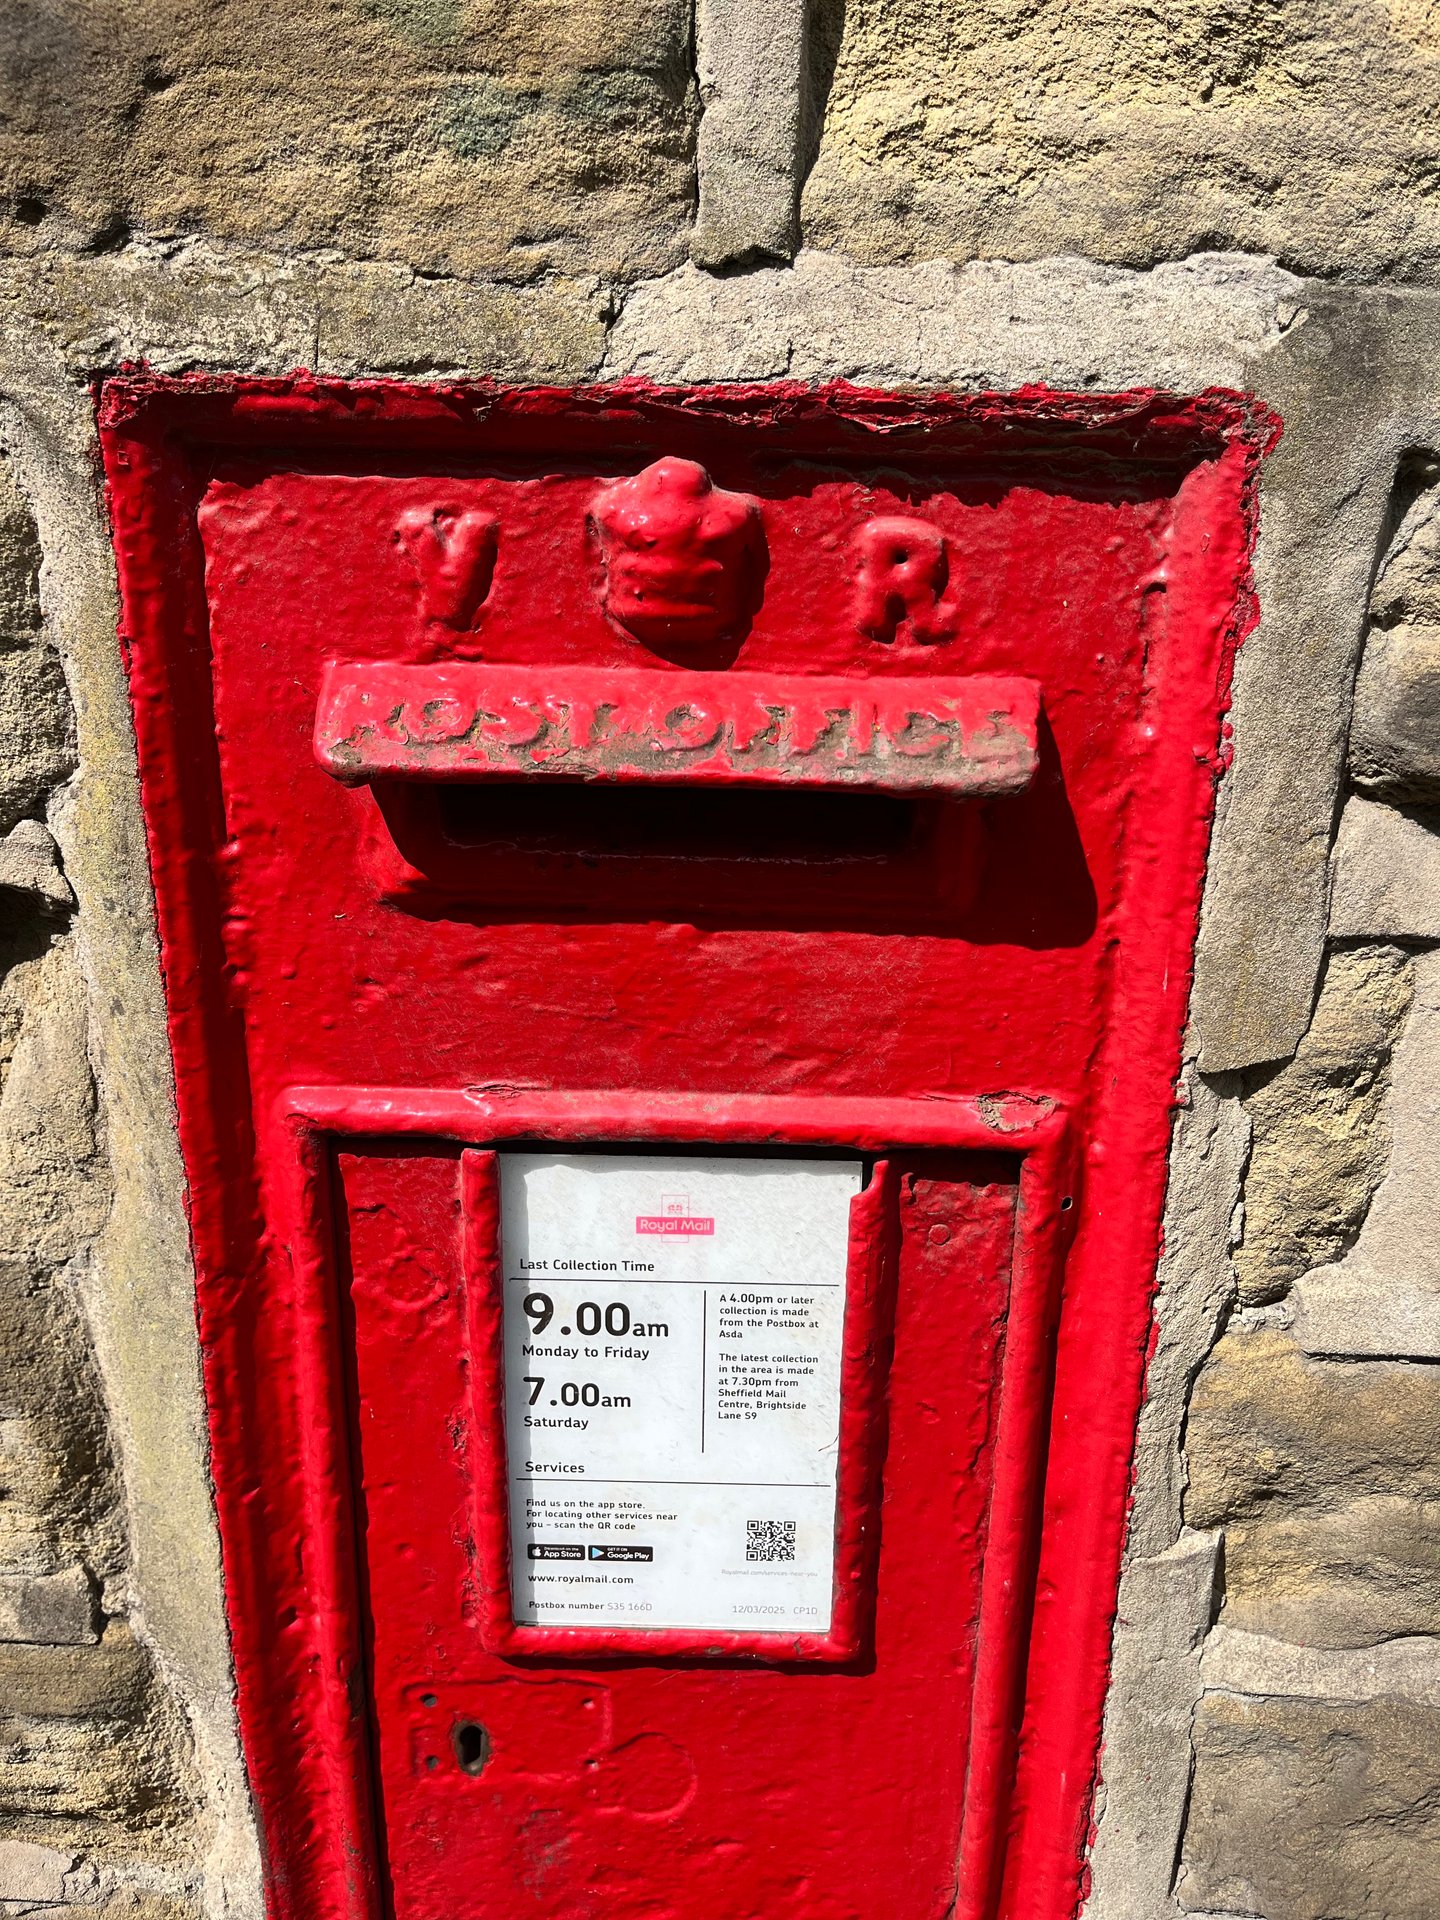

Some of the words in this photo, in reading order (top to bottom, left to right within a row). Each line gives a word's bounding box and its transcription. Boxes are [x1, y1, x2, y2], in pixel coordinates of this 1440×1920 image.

[853, 514, 957, 646] R
[639, 1219, 678, 1234] Royal
[680, 1219, 711, 1232] Mail
[519, 1258, 549, 1270] Last
[552, 1258, 618, 1271] Collection
[620, 1260, 655, 1272] Time
[719, 1293, 727, 1303] A
[729, 1292, 774, 1306] 4.00pm
[790, 1295, 815, 1305] later
[522, 1292, 669, 1340] 9.00am
[719, 1306, 767, 1316] collection
[770, 1307, 779, 1316] is
[782, 1307, 810, 1317] made
[719, 1317, 744, 1327] from
[746, 1318, 764, 1328] the
[766, 1318, 806, 1328] Postbox
[808, 1320, 820, 1329] at
[718, 1330, 743, 1339] Asda
[522, 1343, 580, 1360] Monday
[583, 1346, 599, 1358] to
[604, 1346, 650, 1362] Friday
[718, 1352, 738, 1362] The
[740, 1353, 769, 1363] latest
[771, 1354, 819, 1364] collection
[718, 1364, 728, 1373] in
[730, 1364, 748, 1374] the
[750, 1366, 773, 1374] area
[775, 1365, 784, 1375] is
[787, 1366, 815, 1375] made
[718, 1377, 729, 1386] at
[731, 1376, 772, 1388] 7.30pm
[774, 1377, 799, 1387] from
[522, 1376, 631, 1408] 7.00am
[718, 1388, 763, 1398] Sheffield
[765, 1389, 787, 1398] Mail
[718, 1400, 753, 1412] Centre,
[756, 1400, 807, 1413] Brightside
[717, 1410, 742, 1420] Lane
[744, 1411, 758, 1420] S9
[523, 1415, 589, 1431] Saturday
[524, 1460, 585, 1474] Services
[525, 1498, 547, 1508] Find
[550, 1500, 561, 1508] us
[579, 1500, 595, 1509] the
[597, 1502, 616, 1510] app
[618, 1501, 646, 1510] store.
[526, 1510, 542, 1519] For
[544, 1510, 582, 1521] locating
[585, 1511, 612, 1520] other
[614, 1512, 653, 1521] services
[525, 1521, 544, 1530] you
[578, 1521, 595, 1530] the
[597, 1521, 611, 1530] QR
[614, 1522, 636, 1531] code
[544, 1550, 560, 1559] App
[561, 1550, 582, 1559] Store
[607, 1551, 634, 1560] Google
[634, 1552, 650, 1561] Play
[527, 1574, 634, 1585] www.royalmail.com
[528, 1601, 566, 1610] Postbox
[568, 1601, 605, 1611] number
[607, 1602, 625, 1611] S35
[732, 1605, 786, 1615] 12/03/2025
[793, 1606, 818, 1615] CP1D
